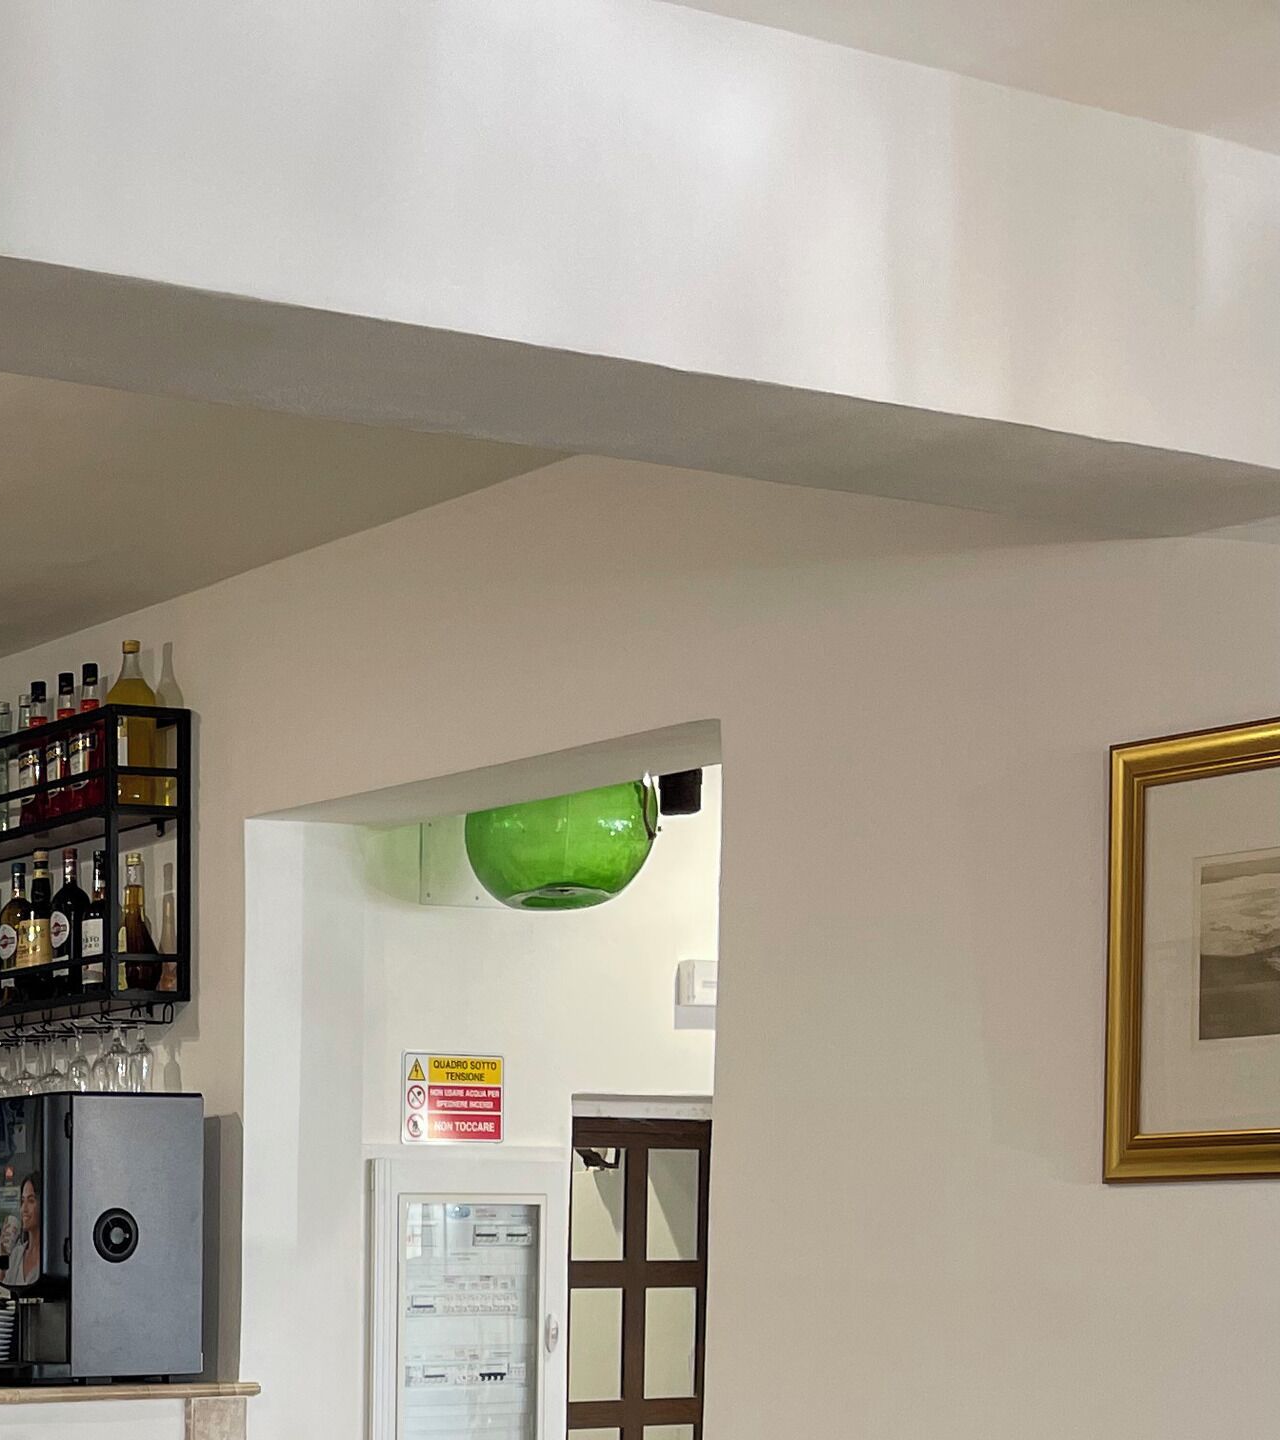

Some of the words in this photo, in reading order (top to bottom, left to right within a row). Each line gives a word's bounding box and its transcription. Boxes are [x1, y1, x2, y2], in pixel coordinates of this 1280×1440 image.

[433, 1060, 468, 1070] QUADRO
[470, 1061, 497, 1071] SOTTO
[445, 1072, 486, 1081] TENSIONE
[488, 1090, 500, 1098] PER
[434, 1121, 453, 1131] NON
[456, 1122, 496, 1132] TOCCARE
